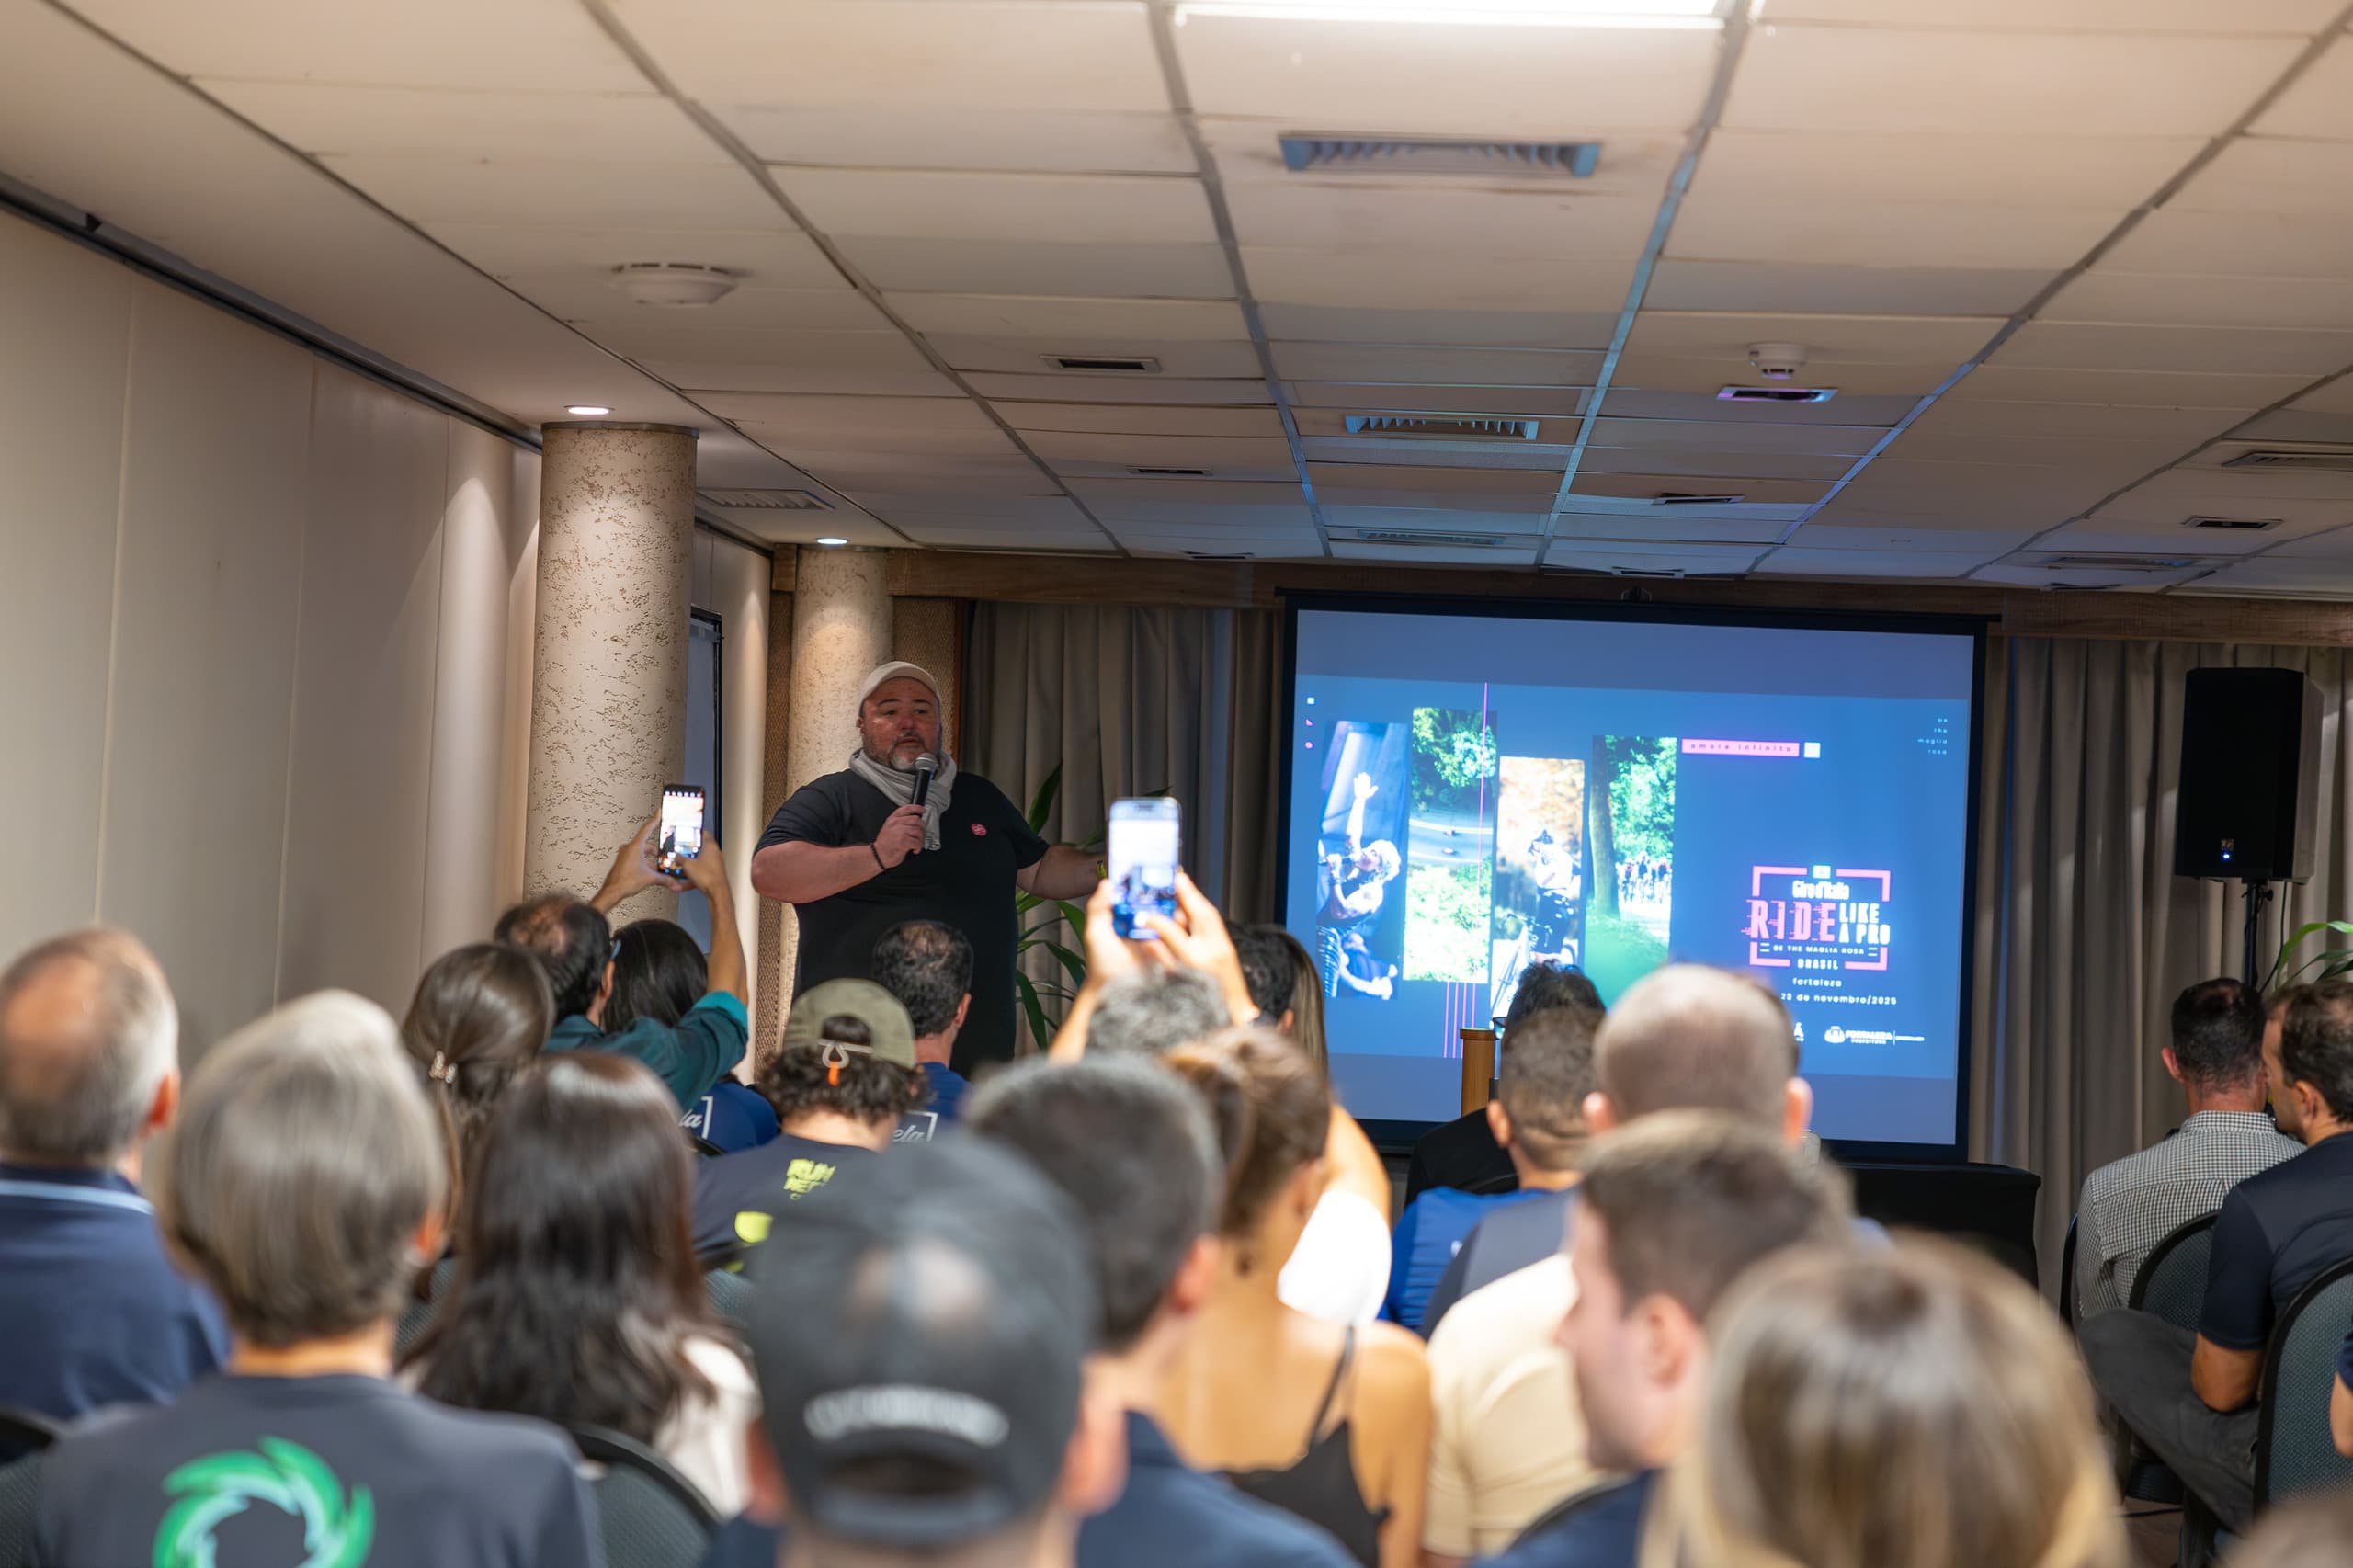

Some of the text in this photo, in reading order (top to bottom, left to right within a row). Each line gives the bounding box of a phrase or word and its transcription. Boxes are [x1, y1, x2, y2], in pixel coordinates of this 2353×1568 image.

[1839, 902, 1880, 924] LIKE
[1746, 899, 1836, 941] RIDE
[1838, 923, 1891, 945] A PRO
[1805, 946, 1838, 954] MAGLIA
[1797, 959, 1839, 971] BRASIL
[1792, 977, 1842, 988] fortaleza
[1780, 993, 1792, 1001] 23
[1796, 994, 1810, 1002] de
